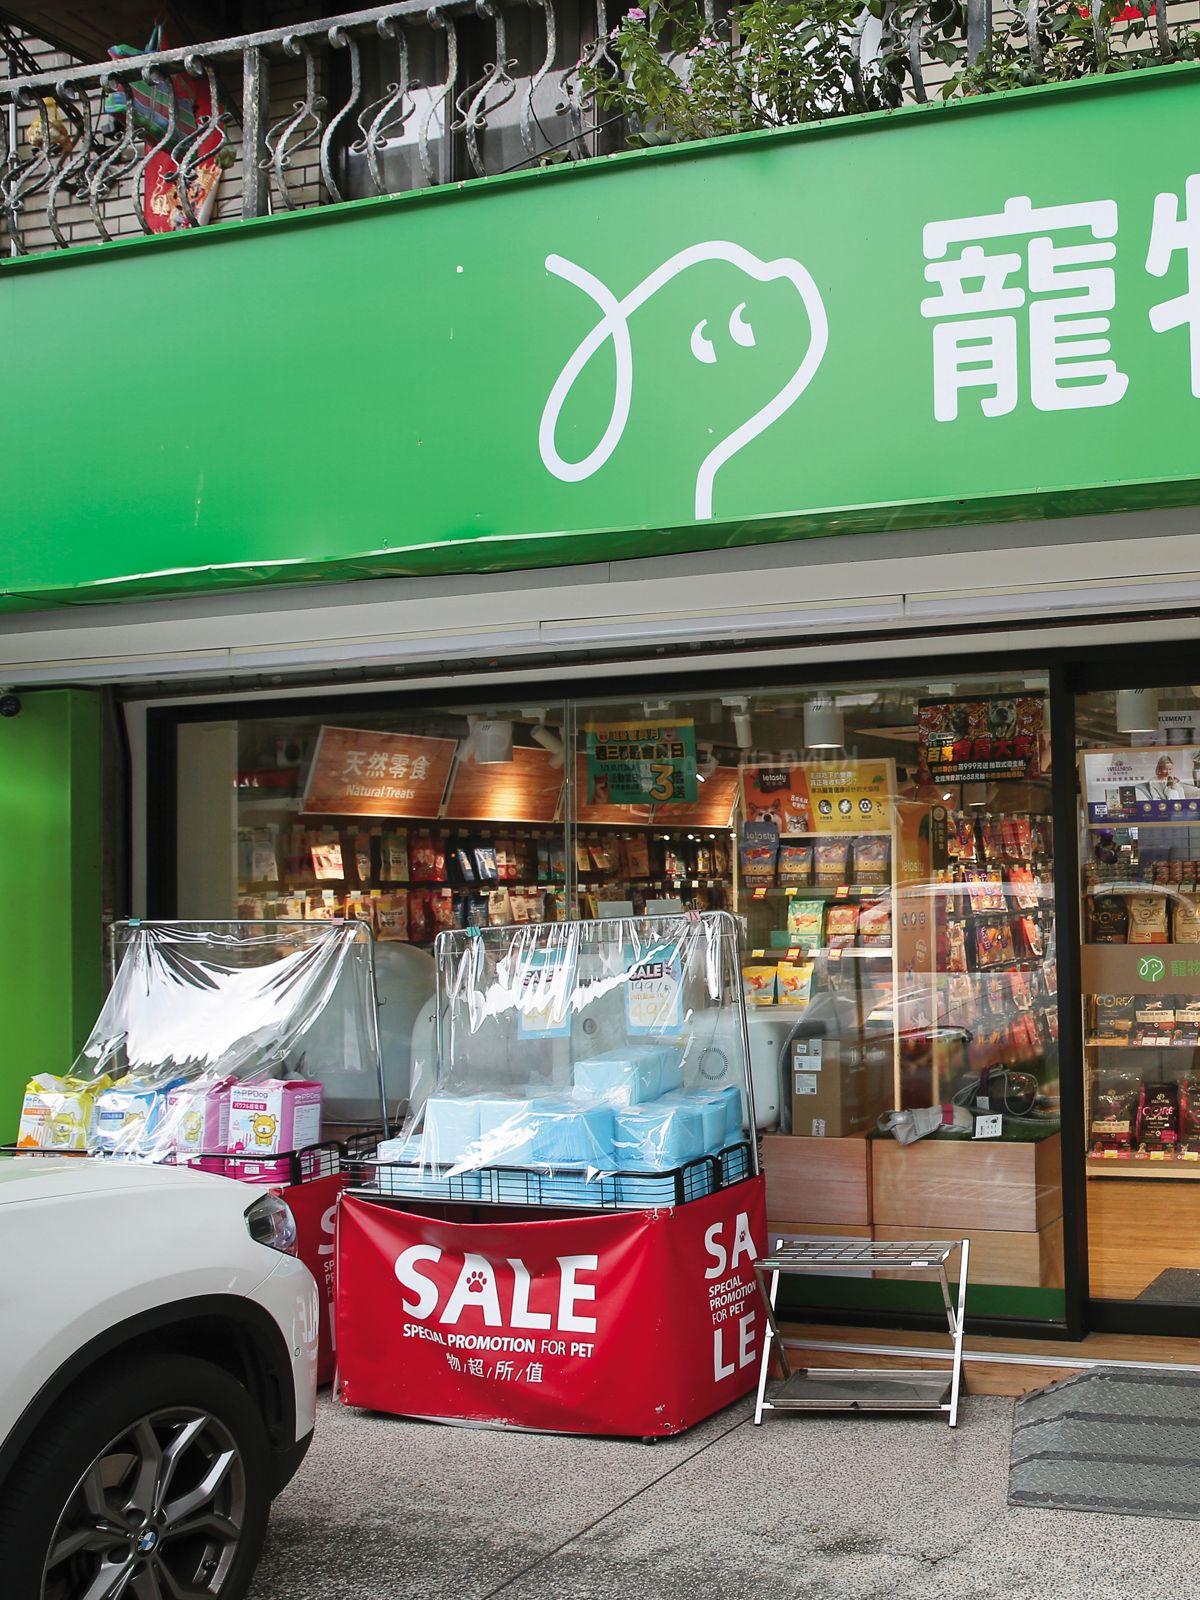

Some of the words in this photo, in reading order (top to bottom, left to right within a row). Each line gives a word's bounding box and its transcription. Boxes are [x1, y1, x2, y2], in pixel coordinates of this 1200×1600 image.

[344, 749, 431, 782] 天然零食
[346, 784, 384, 799] Natural
[387, 786, 416, 800] Treats
[704, 1210, 758, 1280] SA
[393, 1243, 599, 1334] SALE
[708, 1275, 743, 1298] SPECIAL
[709, 1279, 758, 1312] PROMOTION
[712, 1307, 729, 1325] FOR
[729, 1301, 745, 1318] PET
[402, 1323, 447, 1347] SPECIAL
[447, 1333, 535, 1353] PROMOTION
[541, 1340, 566, 1356] FOR
[570, 1342, 595, 1358] PET
[713, 1310, 756, 1383] LE
